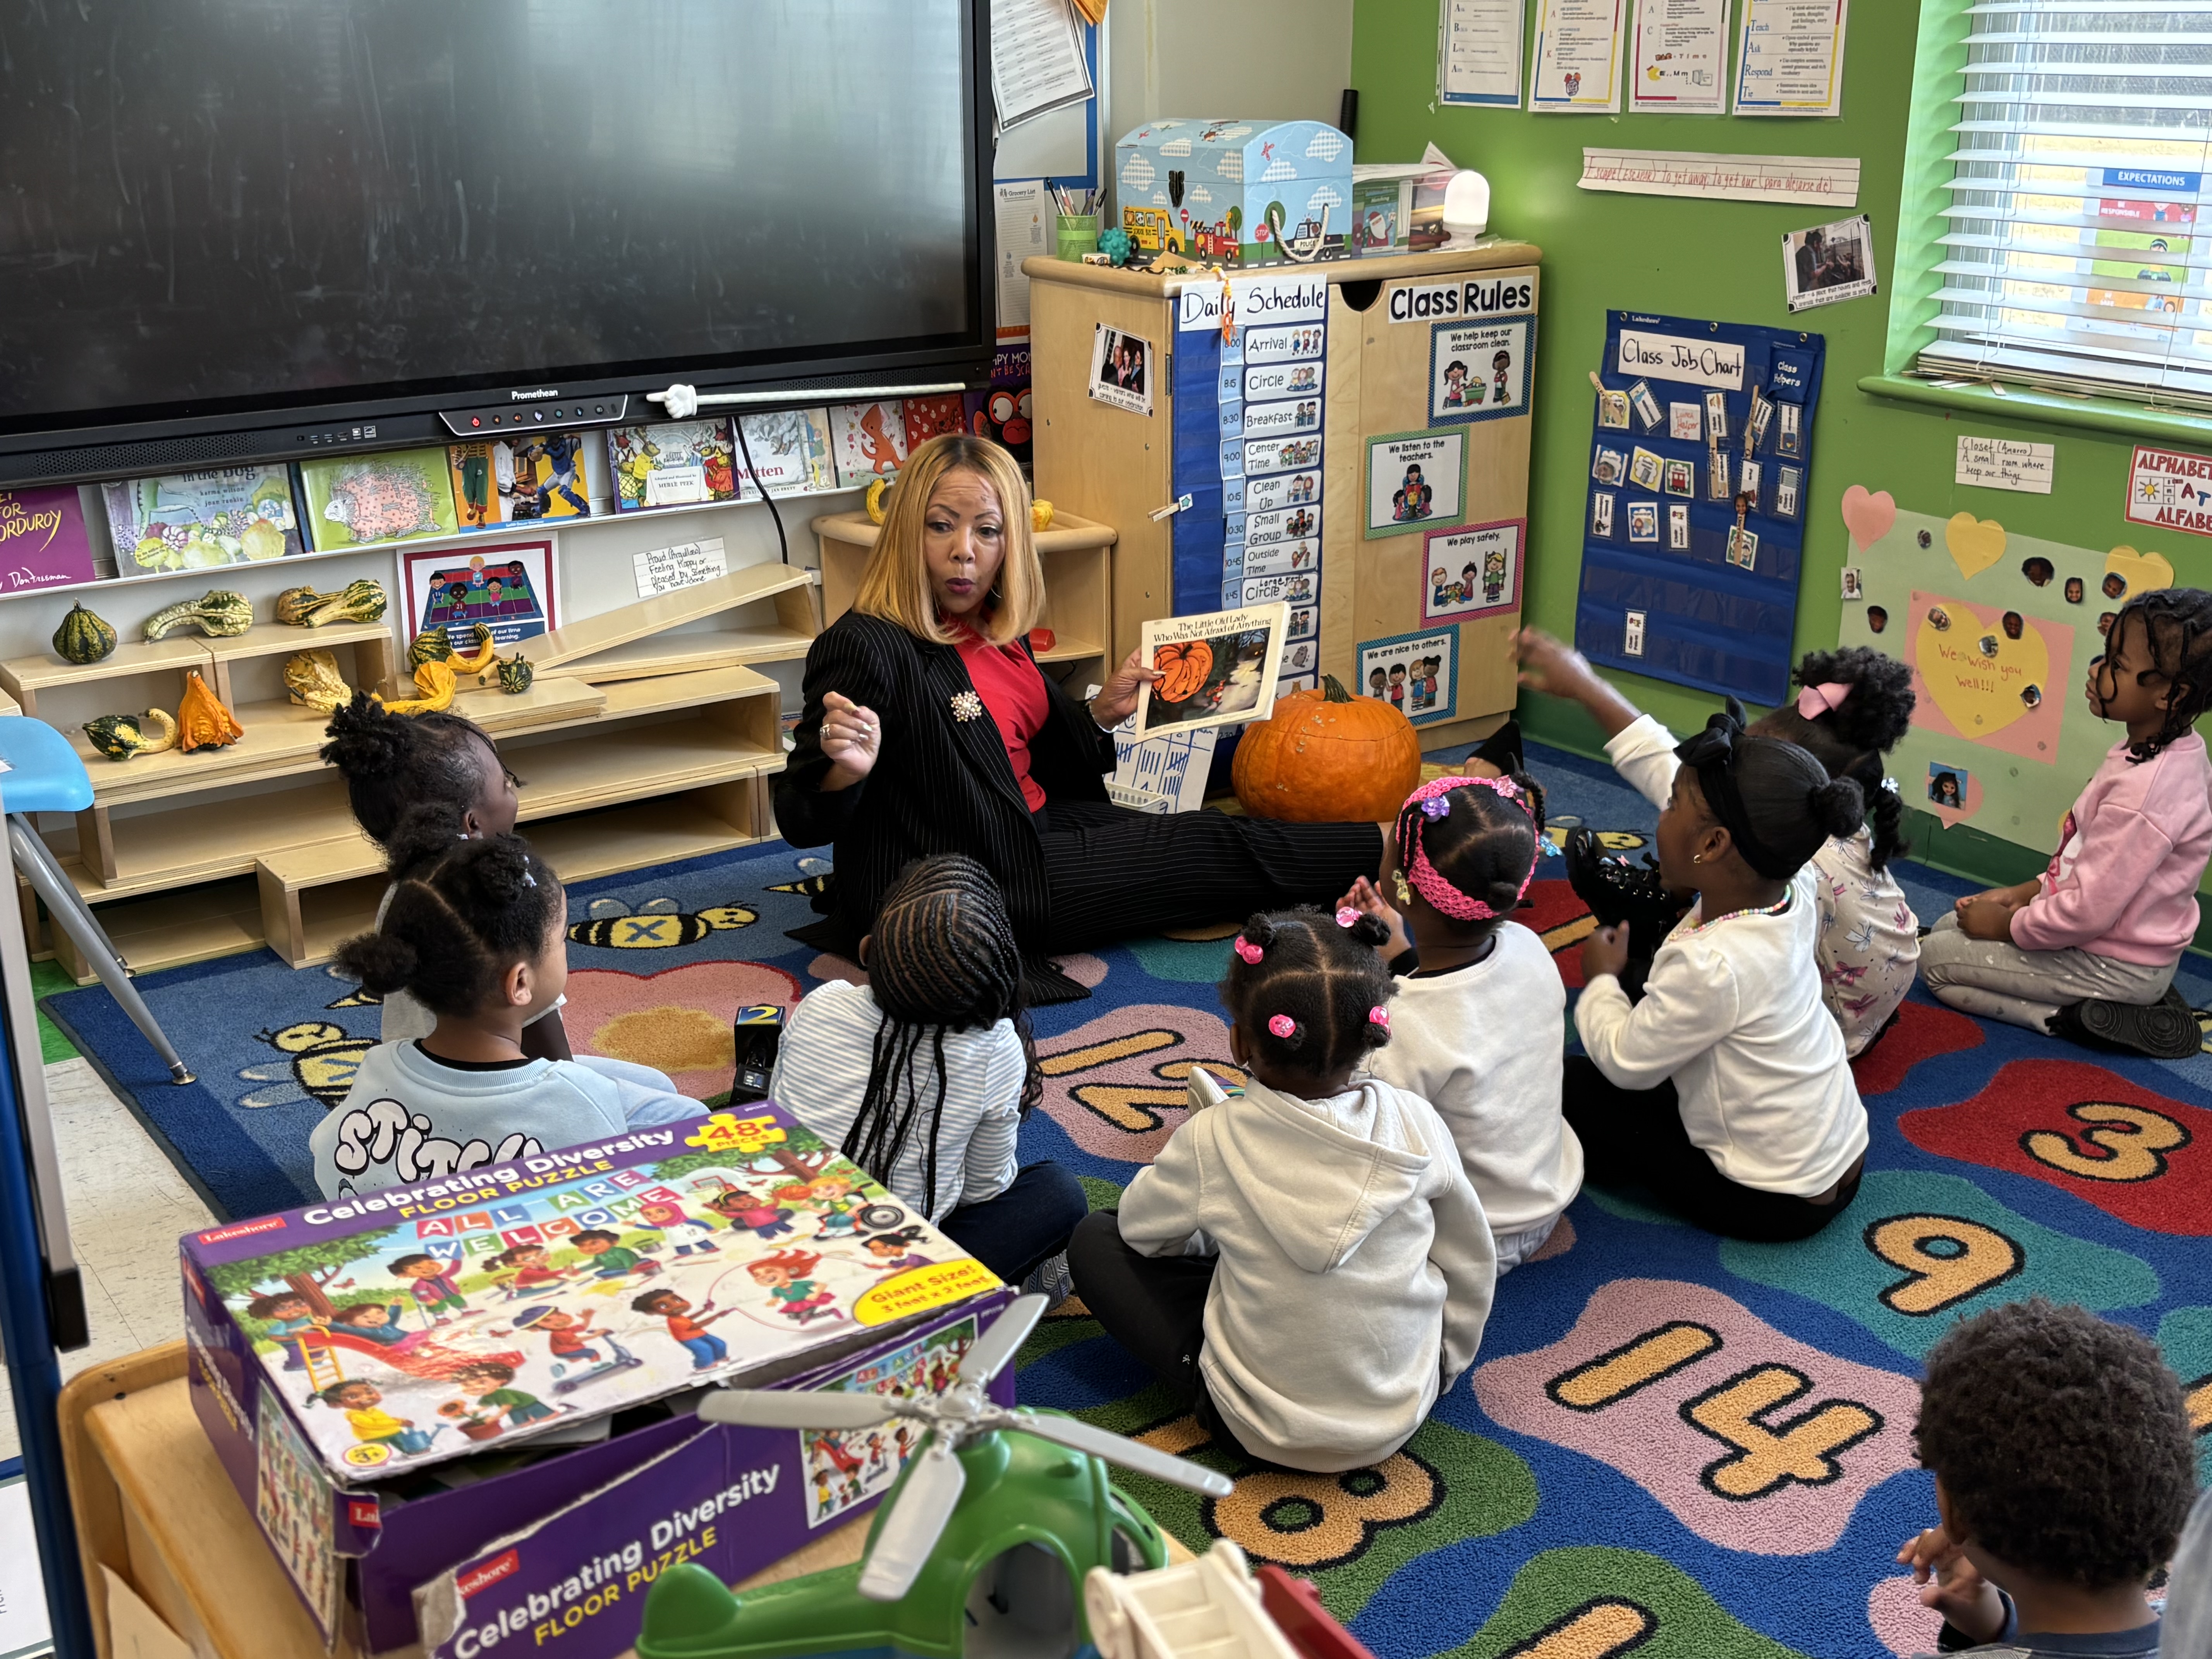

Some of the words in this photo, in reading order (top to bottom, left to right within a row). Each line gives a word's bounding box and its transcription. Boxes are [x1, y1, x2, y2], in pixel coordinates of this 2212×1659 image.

[1750, 20, 1769, 32] Teach
[1747, 41, 1761, 53] Ask
[1745, 64, 1773, 78] Respond
[1743, 86, 1753, 98] Tie
[2118, 171, 2185, 186] EXPECTATIONS
[1255, 228, 1268, 237] STOP
[1247, 283, 1324, 313] Schedule
[1390, 288, 1458, 320] Class
[1463, 280, 1531, 314] Rules
[1451, 333, 1462, 342] We
[1463, 331, 1479, 342] help
[1480, 330, 1498, 339] keep
[1248, 337, 1287, 352] Arrival
[1451, 341, 1489, 352] classroom
[1623, 338, 1663, 364] Class
[1671, 345, 1698, 370] Job
[1700, 348, 1741, 377] Chart
[1778, 361, 1798, 374] Class
[1249, 375, 1284, 390] Circle
[512, 388, 558, 400] Promethean
[1223, 413, 1239, 425] 8:30
[1246, 412, 1293, 428] Breakfast
[1248, 443, 1280, 455] Center
[1388, 445, 1400, 454] We
[1401, 443, 1421, 452] listen
[1423, 441, 1431, 449] to
[1433, 440, 1445, 448] the
[1962, 437, 1994, 452] Closet
[1399, 452, 1433, 462] teachers.
[1963, 448, 1969, 462] A
[1973, 452, 1995, 465] small
[1248, 458, 1270, 471] Time
[737, 465, 784, 480] Mtten
[1966, 464, 1982, 481] keep
[1253, 480, 1281, 495] Clean
[0, 502, 27, 519] OR
[1259, 497, 1274, 510] Up
[1254, 513, 1280, 529] Small
[0, 509, 62, 552] ORDUROY
[1249, 530, 1282, 545] Group
[1447, 538, 1458, 547] We
[1460, 536, 1475, 547] play
[1476, 532, 1501, 543] safely.
[646, 551, 666, 564] Proud
[1248, 548, 1279, 562] Outside
[649, 563, 675, 575] Feeling
[1246, 565, 1267, 576] Time
[1245, 586, 1280, 601] Circle
[1154, 634, 1173, 642] Who
[1173, 631, 1189, 641] Was
[1190, 630, 1203, 639] Not
[1204, 624, 1227, 637] Afraid
[1227, 623, 1235, 632] of
[1235, 618, 1272, 630] Anything
[1177, 622, 1194, 632] The
[1194, 619, 1213, 630] Little
[1214, 615, 1229, 626] Old
[1229, 613, 1248, 623] Lady
[1367, 651, 1379, 660] We
[1380, 649, 1393, 658] are
[1395, 645, 1410, 654] nice
[1412, 643, 1420, 651] to
[1421, 638, 1446, 649] others.
[1939, 644, 1957, 661] We
[2001, 665, 2022, 682] you
[738, 1006, 778, 1025] 2
[708, 1122, 763, 1140] 48
[716, 1134, 770, 1147] PIECES
[2018, 1101, 2194, 1183] 3
[304, 1165, 520, 1224] Celebrating
[525, 1130, 674, 1174] Diversity
[398, 1187, 500, 1218] FLOOR
[505, 1160, 614, 1193] PUZZLE
[421, 1208, 523, 1236] ALL
[558, 1173, 641, 1209] ARE
[204, 1221, 278, 1242] Lakeshore
[428, 1189, 675, 1259] WELCOME
[1863, 1212, 2025, 1316] 9
[871, 1282, 927, 1303] Giant
[927, 1264, 977, 1286] Size!
[881, 1304, 893, 1313] 3
[1545, 1320, 1885, 1500] 14
[454, 1540, 642, 1659] Celebrating
[650, 1464, 780, 1551] Diversity
[534, 1584, 620, 1647] FLOOR
[627, 1526, 718, 1592] PUZZLE
